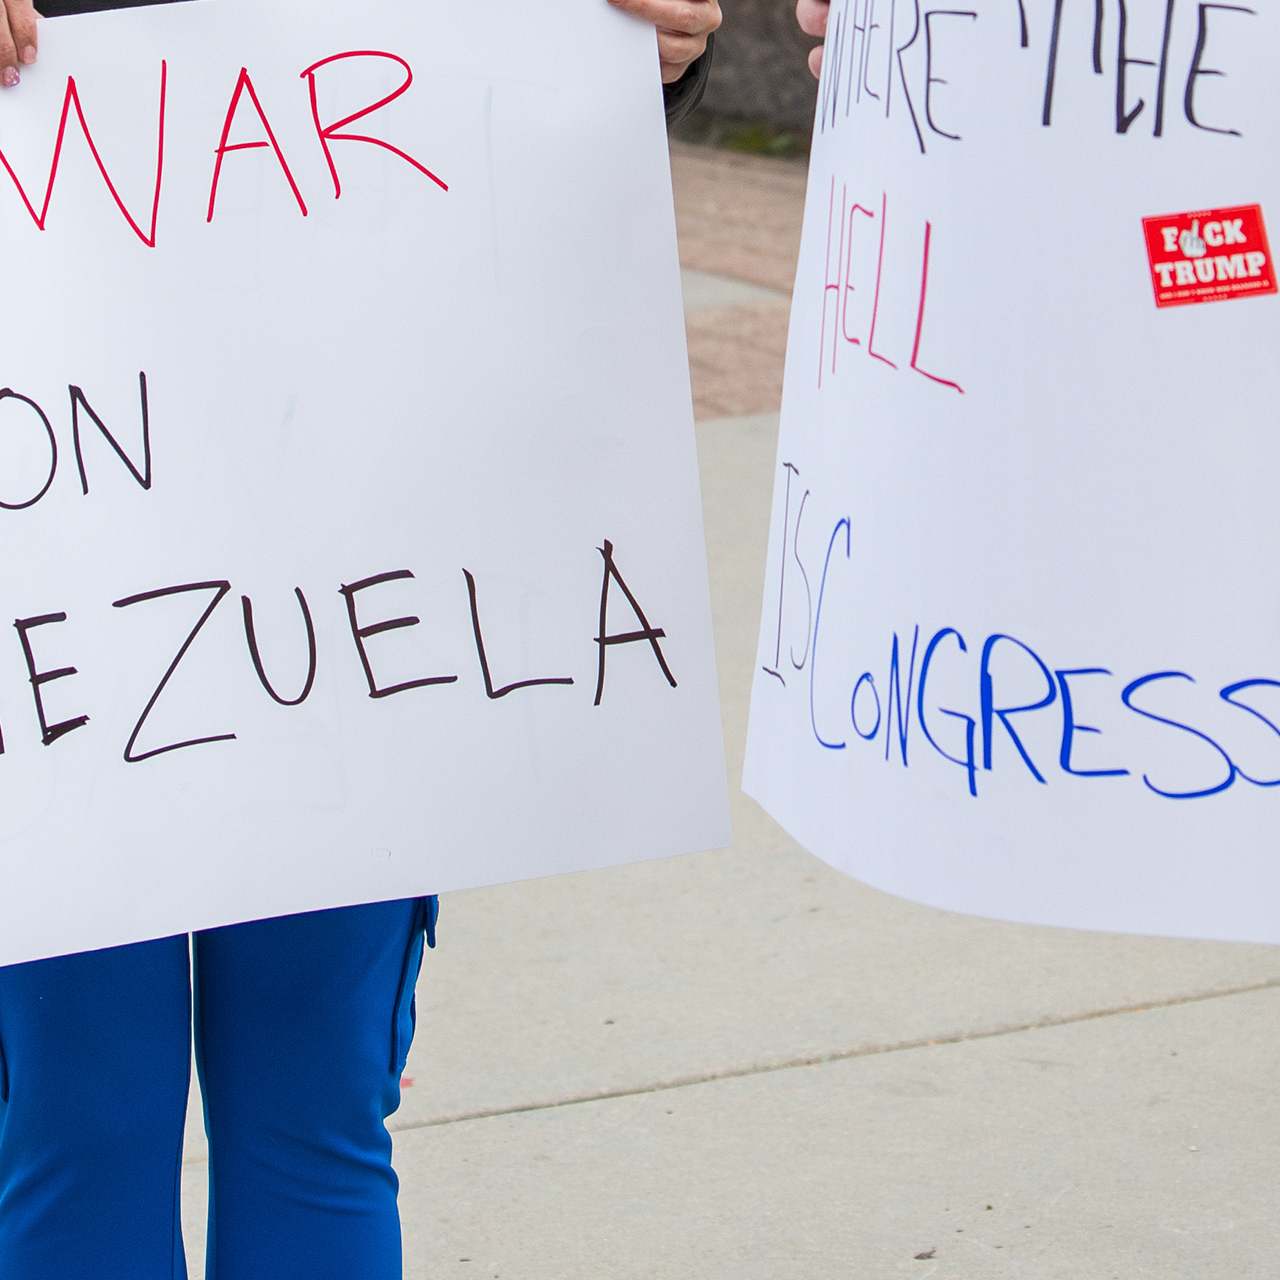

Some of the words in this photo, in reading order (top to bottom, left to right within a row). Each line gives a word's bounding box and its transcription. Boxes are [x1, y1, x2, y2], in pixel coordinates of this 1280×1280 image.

[818, 175, 965, 393] HELL
[1154, 251, 1266, 287] TRUMP
[1160, 218, 1247, 258] FCK
[762, 462, 812, 687] IS
